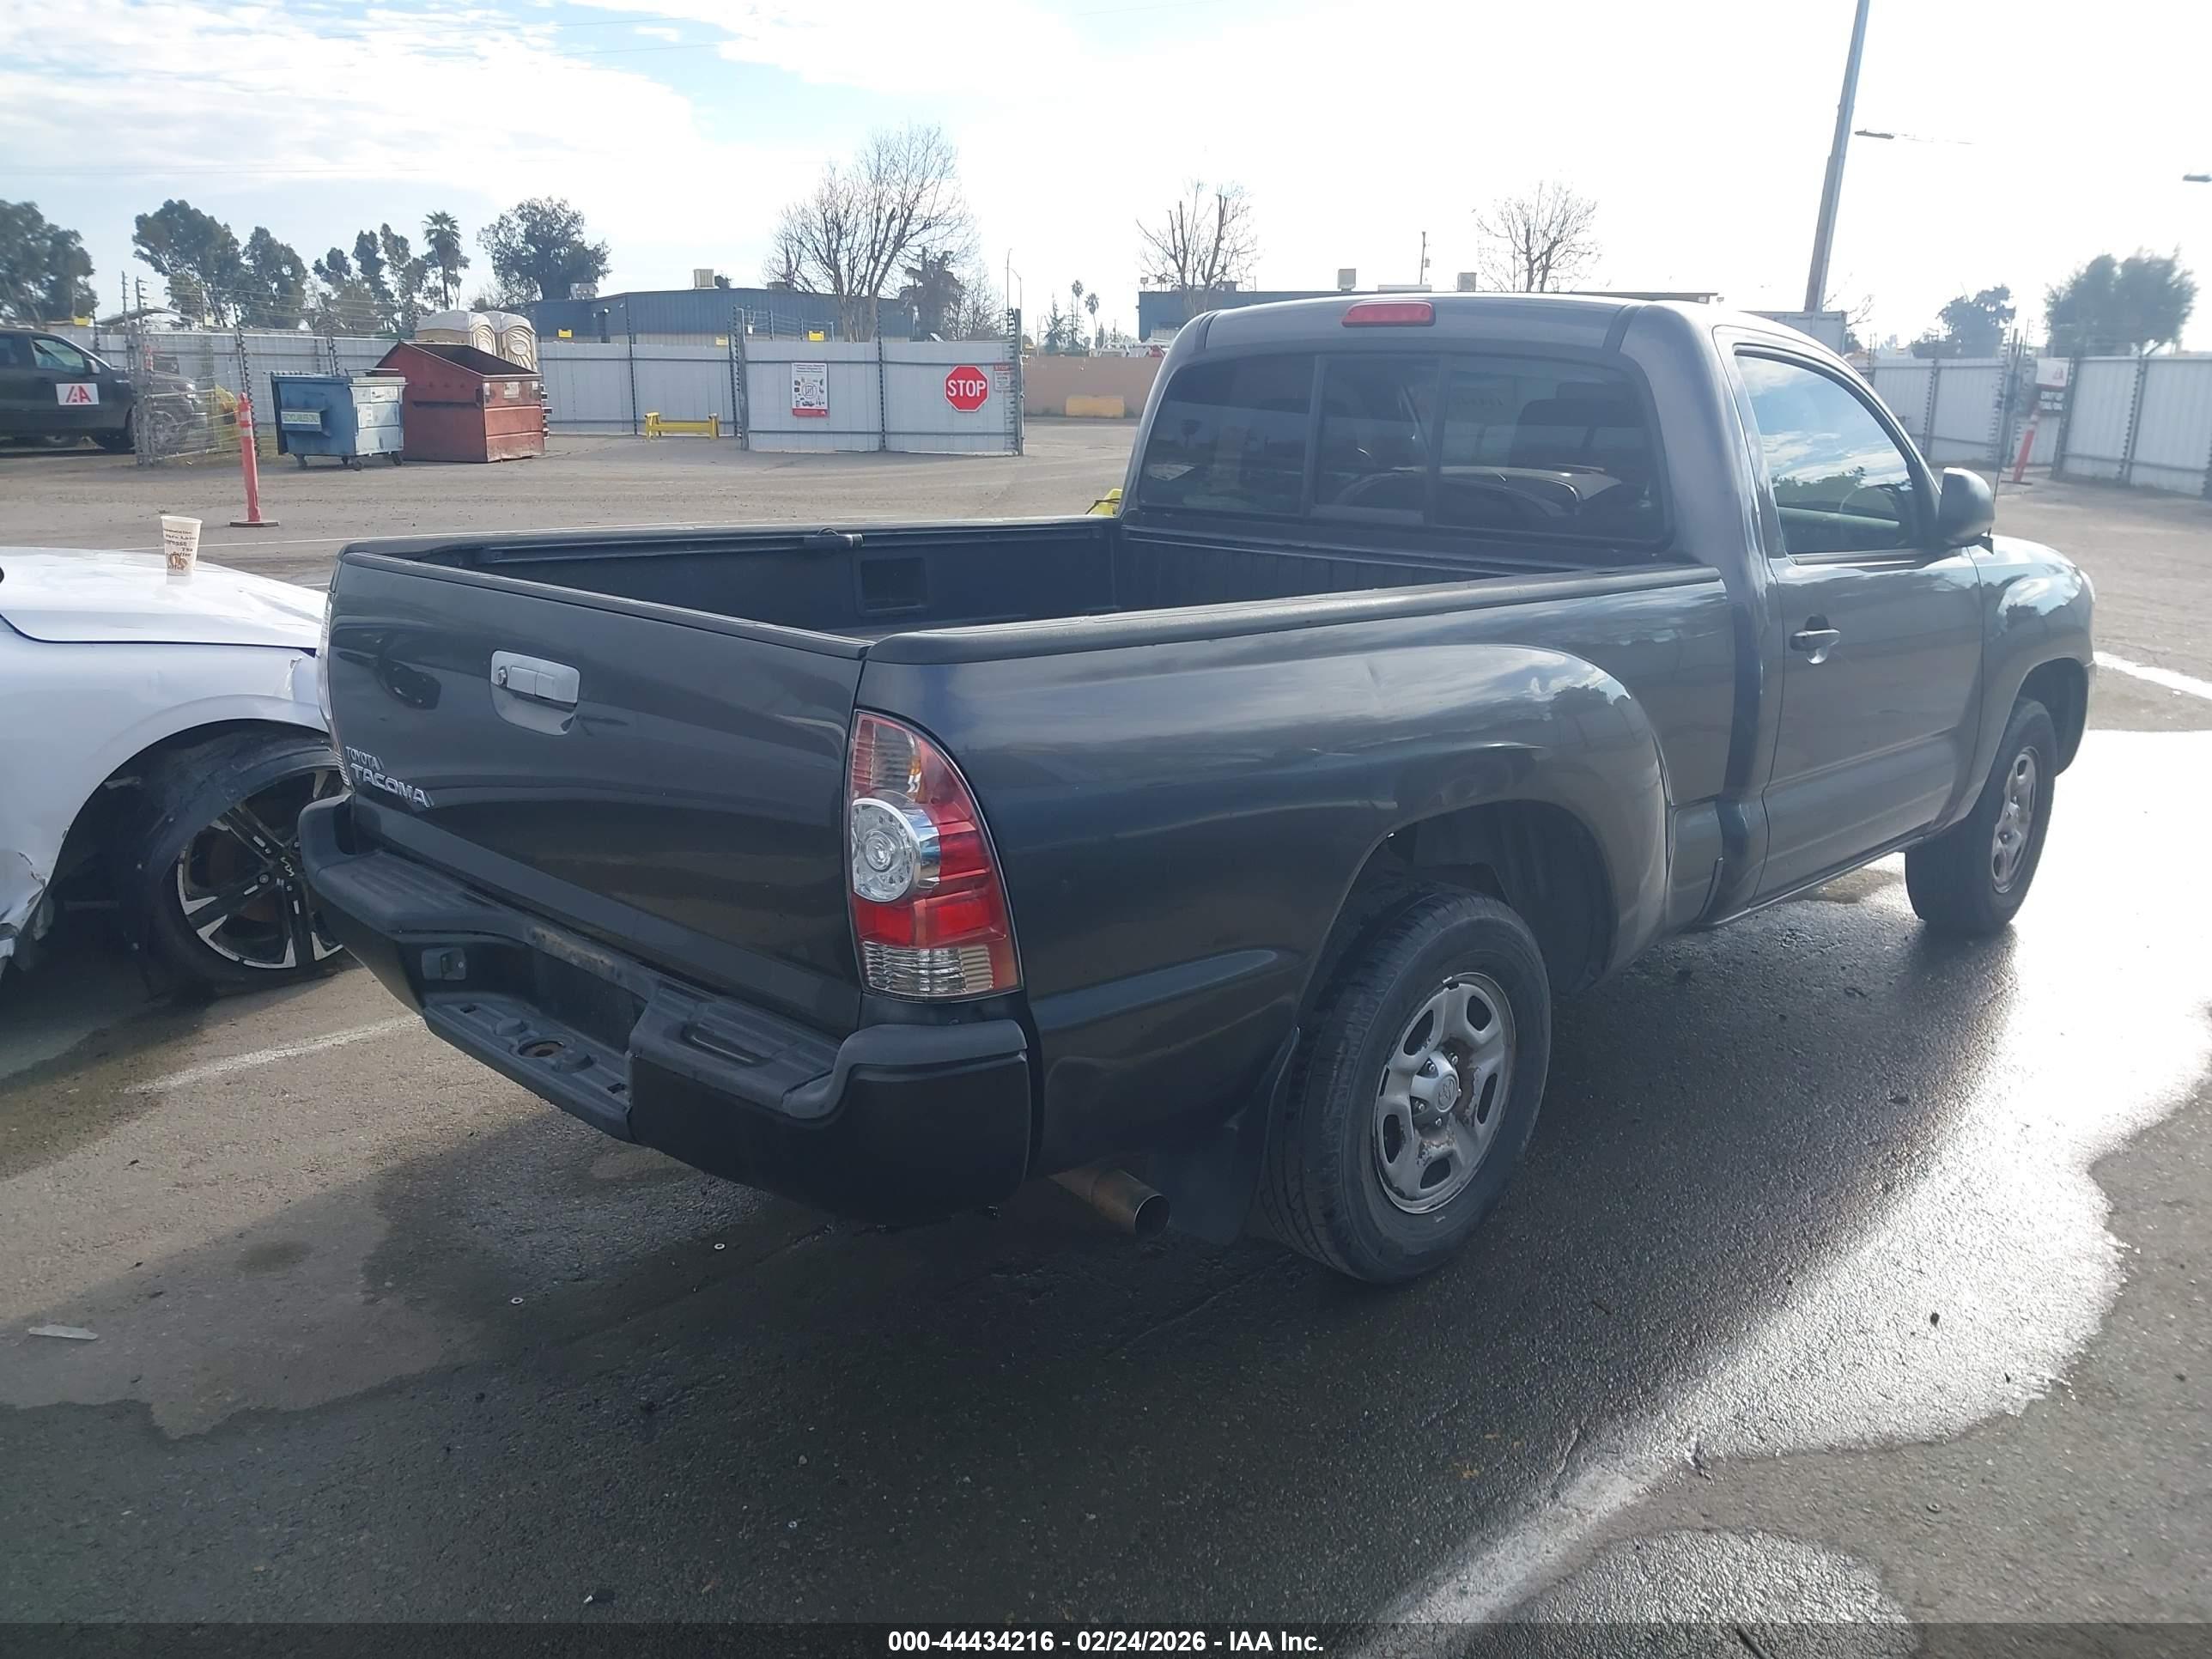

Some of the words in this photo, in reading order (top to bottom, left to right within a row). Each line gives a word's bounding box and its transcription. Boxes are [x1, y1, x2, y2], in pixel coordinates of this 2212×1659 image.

[947, 380, 987, 398] STOP
[345, 746, 380, 770] TOYOTA
[350, 763, 430, 807] TACOMA
